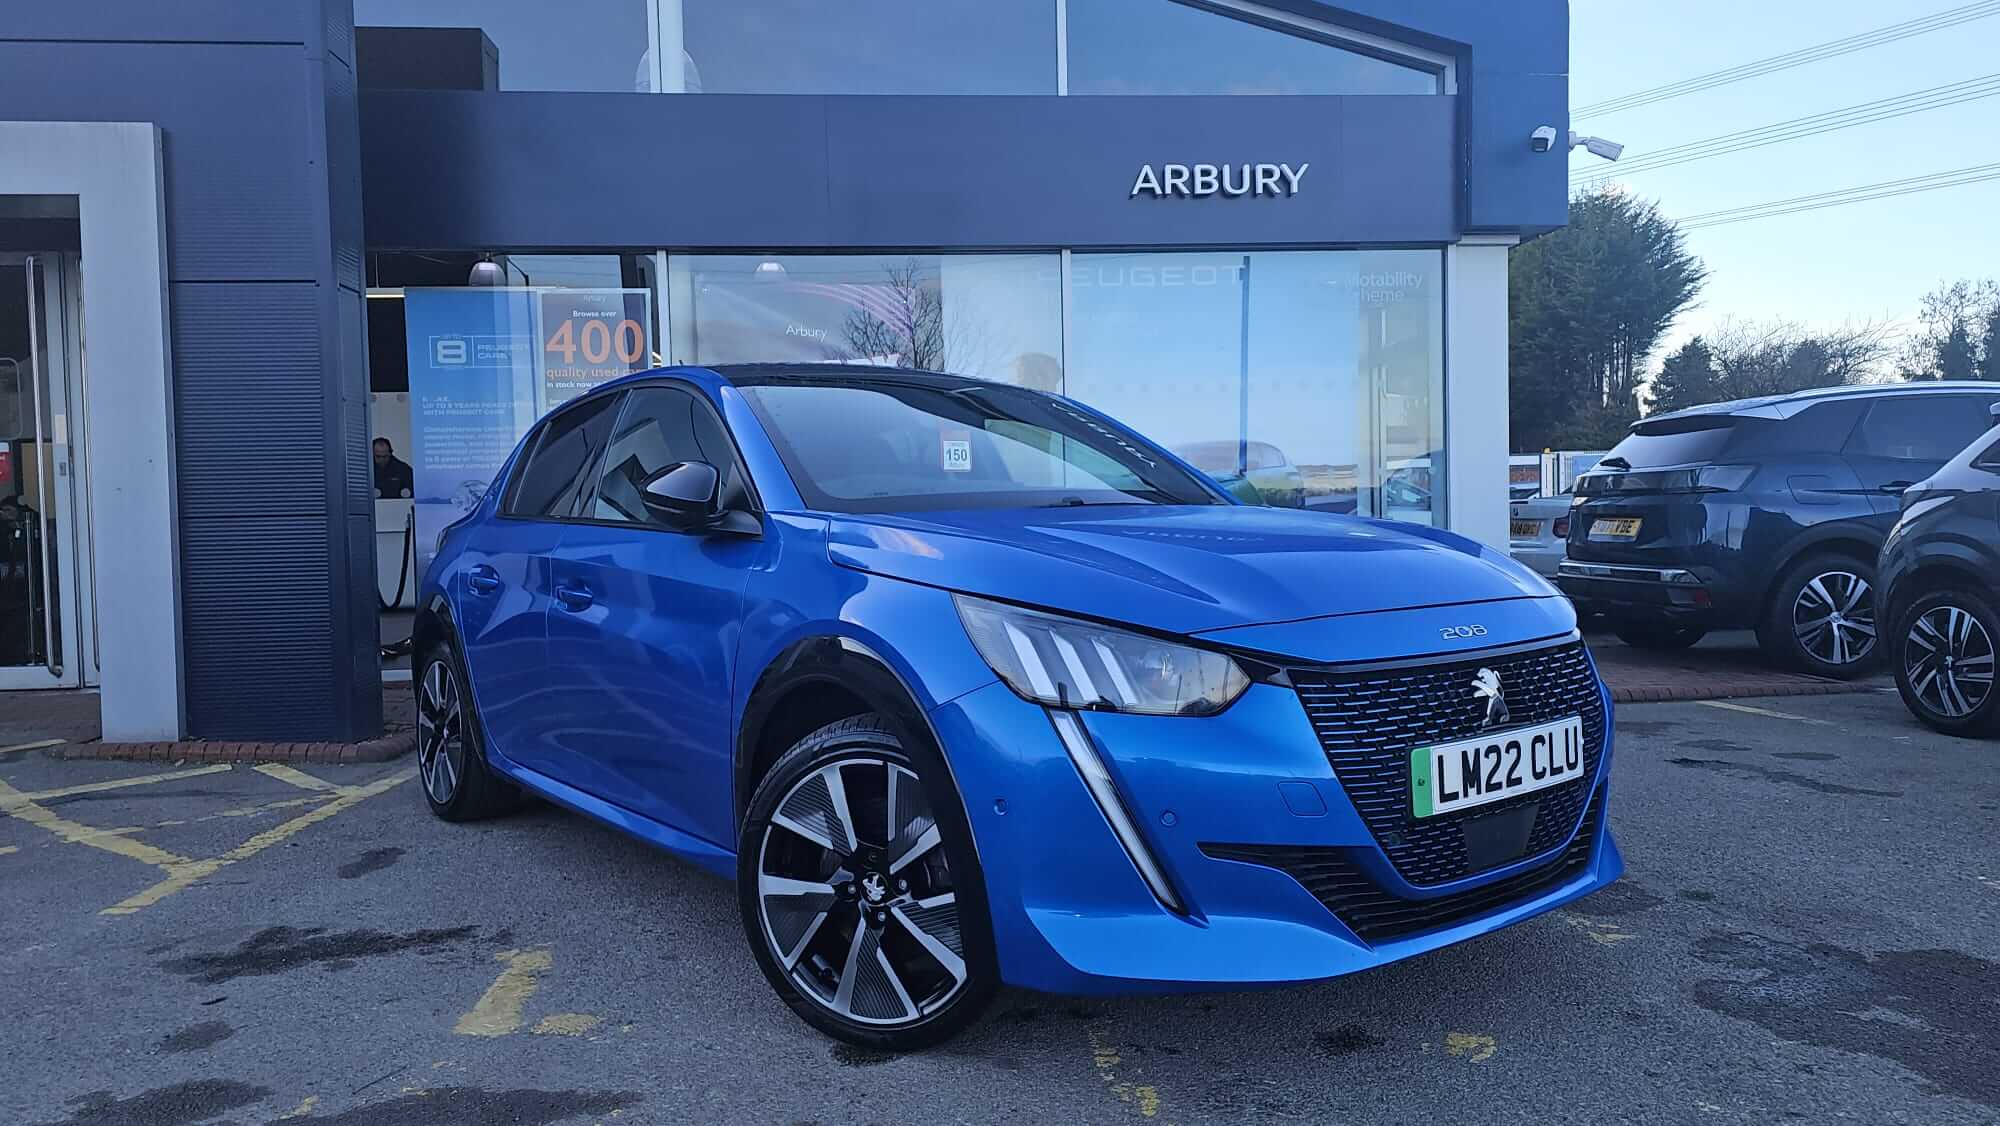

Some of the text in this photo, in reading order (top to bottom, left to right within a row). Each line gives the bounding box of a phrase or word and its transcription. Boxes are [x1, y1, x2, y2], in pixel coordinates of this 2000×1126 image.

[1131, 163, 1309, 195] ARBURY
[1040, 265, 1246, 287] EUGEOT
[1352, 288, 1404, 302] heme
[572, 310, 618, 318] Browse over
[785, 323, 828, 342] Arbury
[545, 319, 644, 364] 400
[546, 367, 588, 380] quality
[591, 367, 620, 378] used
[556, 380, 575, 389] stock
[945, 448, 968, 461] 150
[1439, 624, 1488, 640] 208
[1437, 726, 1579, 804] LM22 CLU
